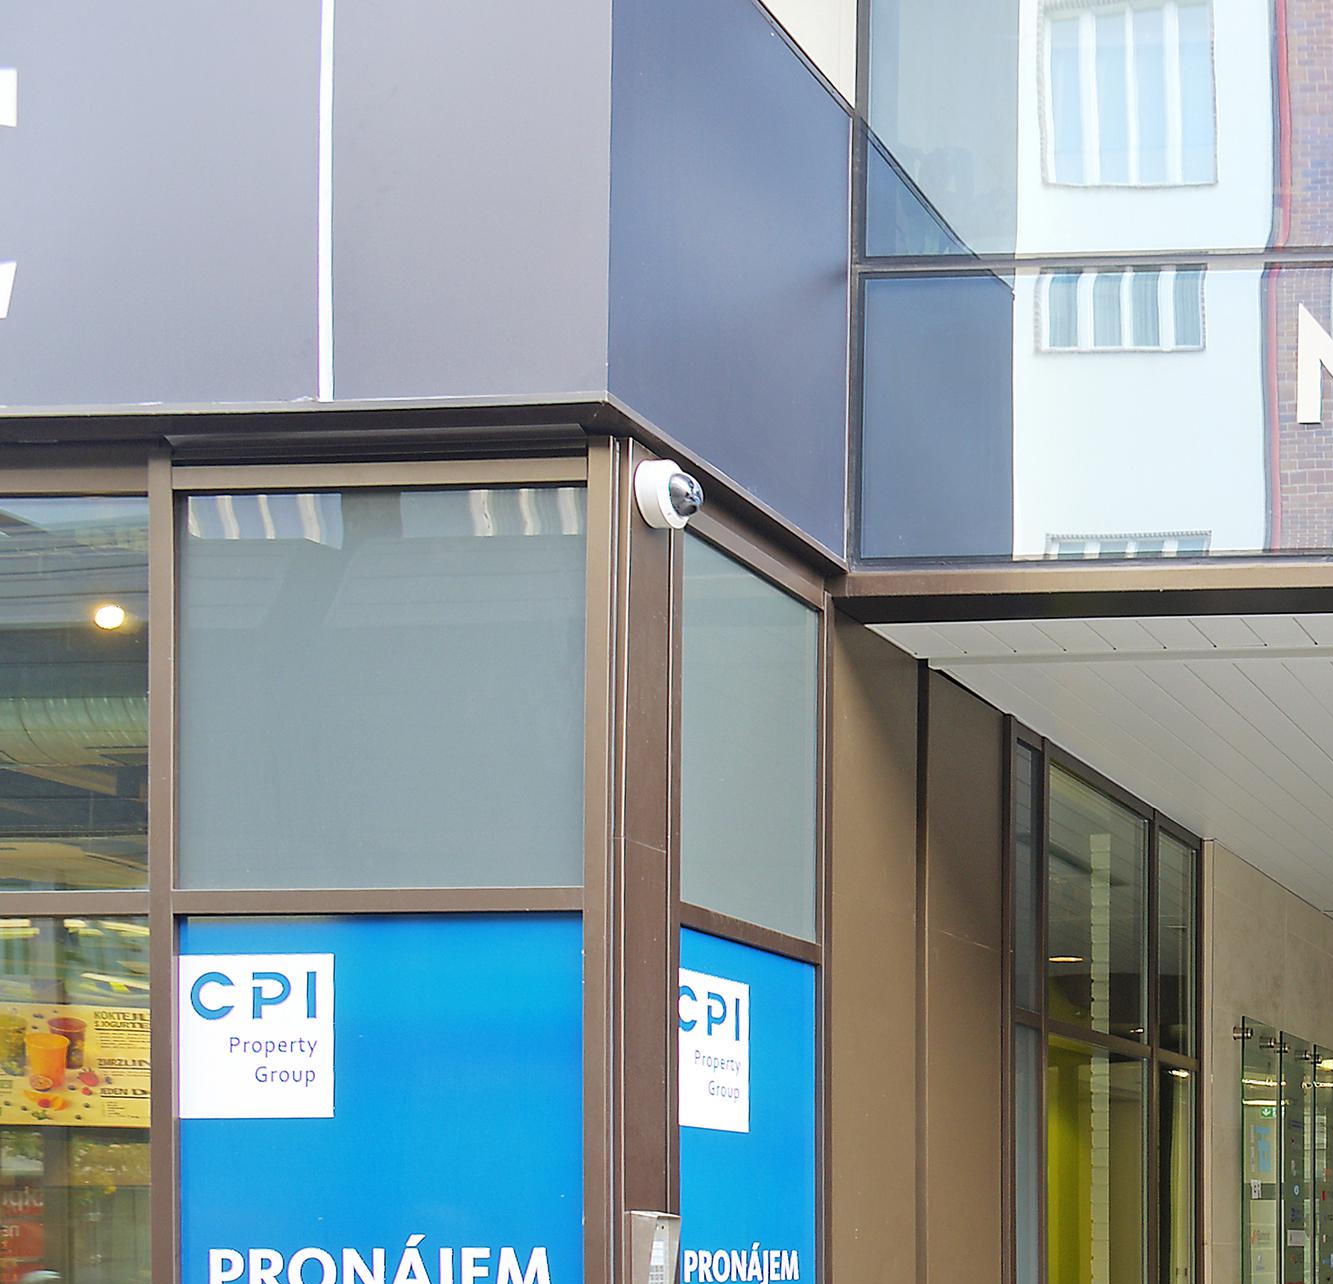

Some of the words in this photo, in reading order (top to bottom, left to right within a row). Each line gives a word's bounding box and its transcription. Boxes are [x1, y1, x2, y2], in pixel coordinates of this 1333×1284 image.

[190, 971, 317, 1021] CPI
[679, 985, 740, 1041] CPI
[229, 1036, 318, 1058] Property
[694, 1049, 741, 1076] Property
[254, 1065, 317, 1088] Group
[707, 1080, 740, 1104] Group
